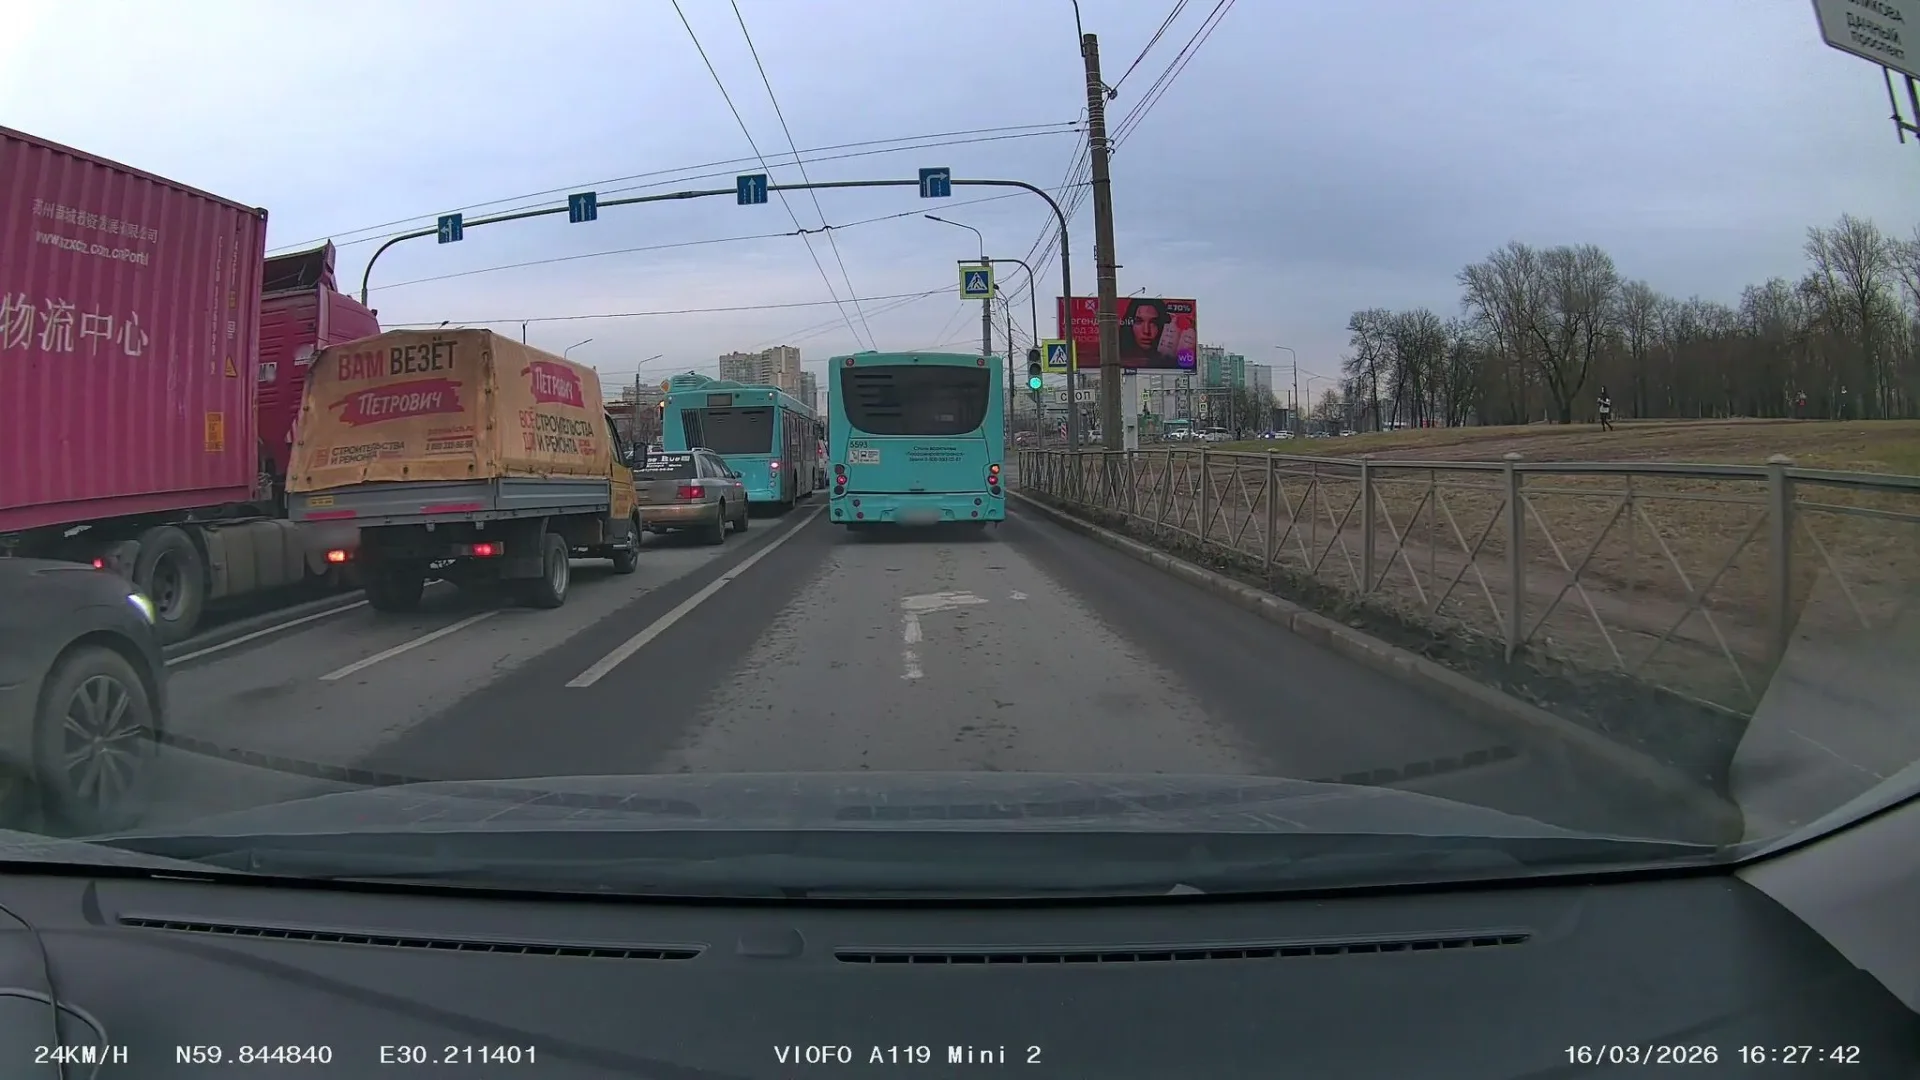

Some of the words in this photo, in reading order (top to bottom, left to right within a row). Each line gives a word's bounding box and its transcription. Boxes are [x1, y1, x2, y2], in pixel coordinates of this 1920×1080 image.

[0, 291, 149, 356] 物流中心
[338, 350, 384, 381] ВАМ
[390, 336, 458, 376] ВЕЗЁТ
[1178, 353, 1194, 363] wb
[1060, 391, 1091, 401] СОП
[332, 441, 405, 456] СТРОИТЕЛЬСТВА
